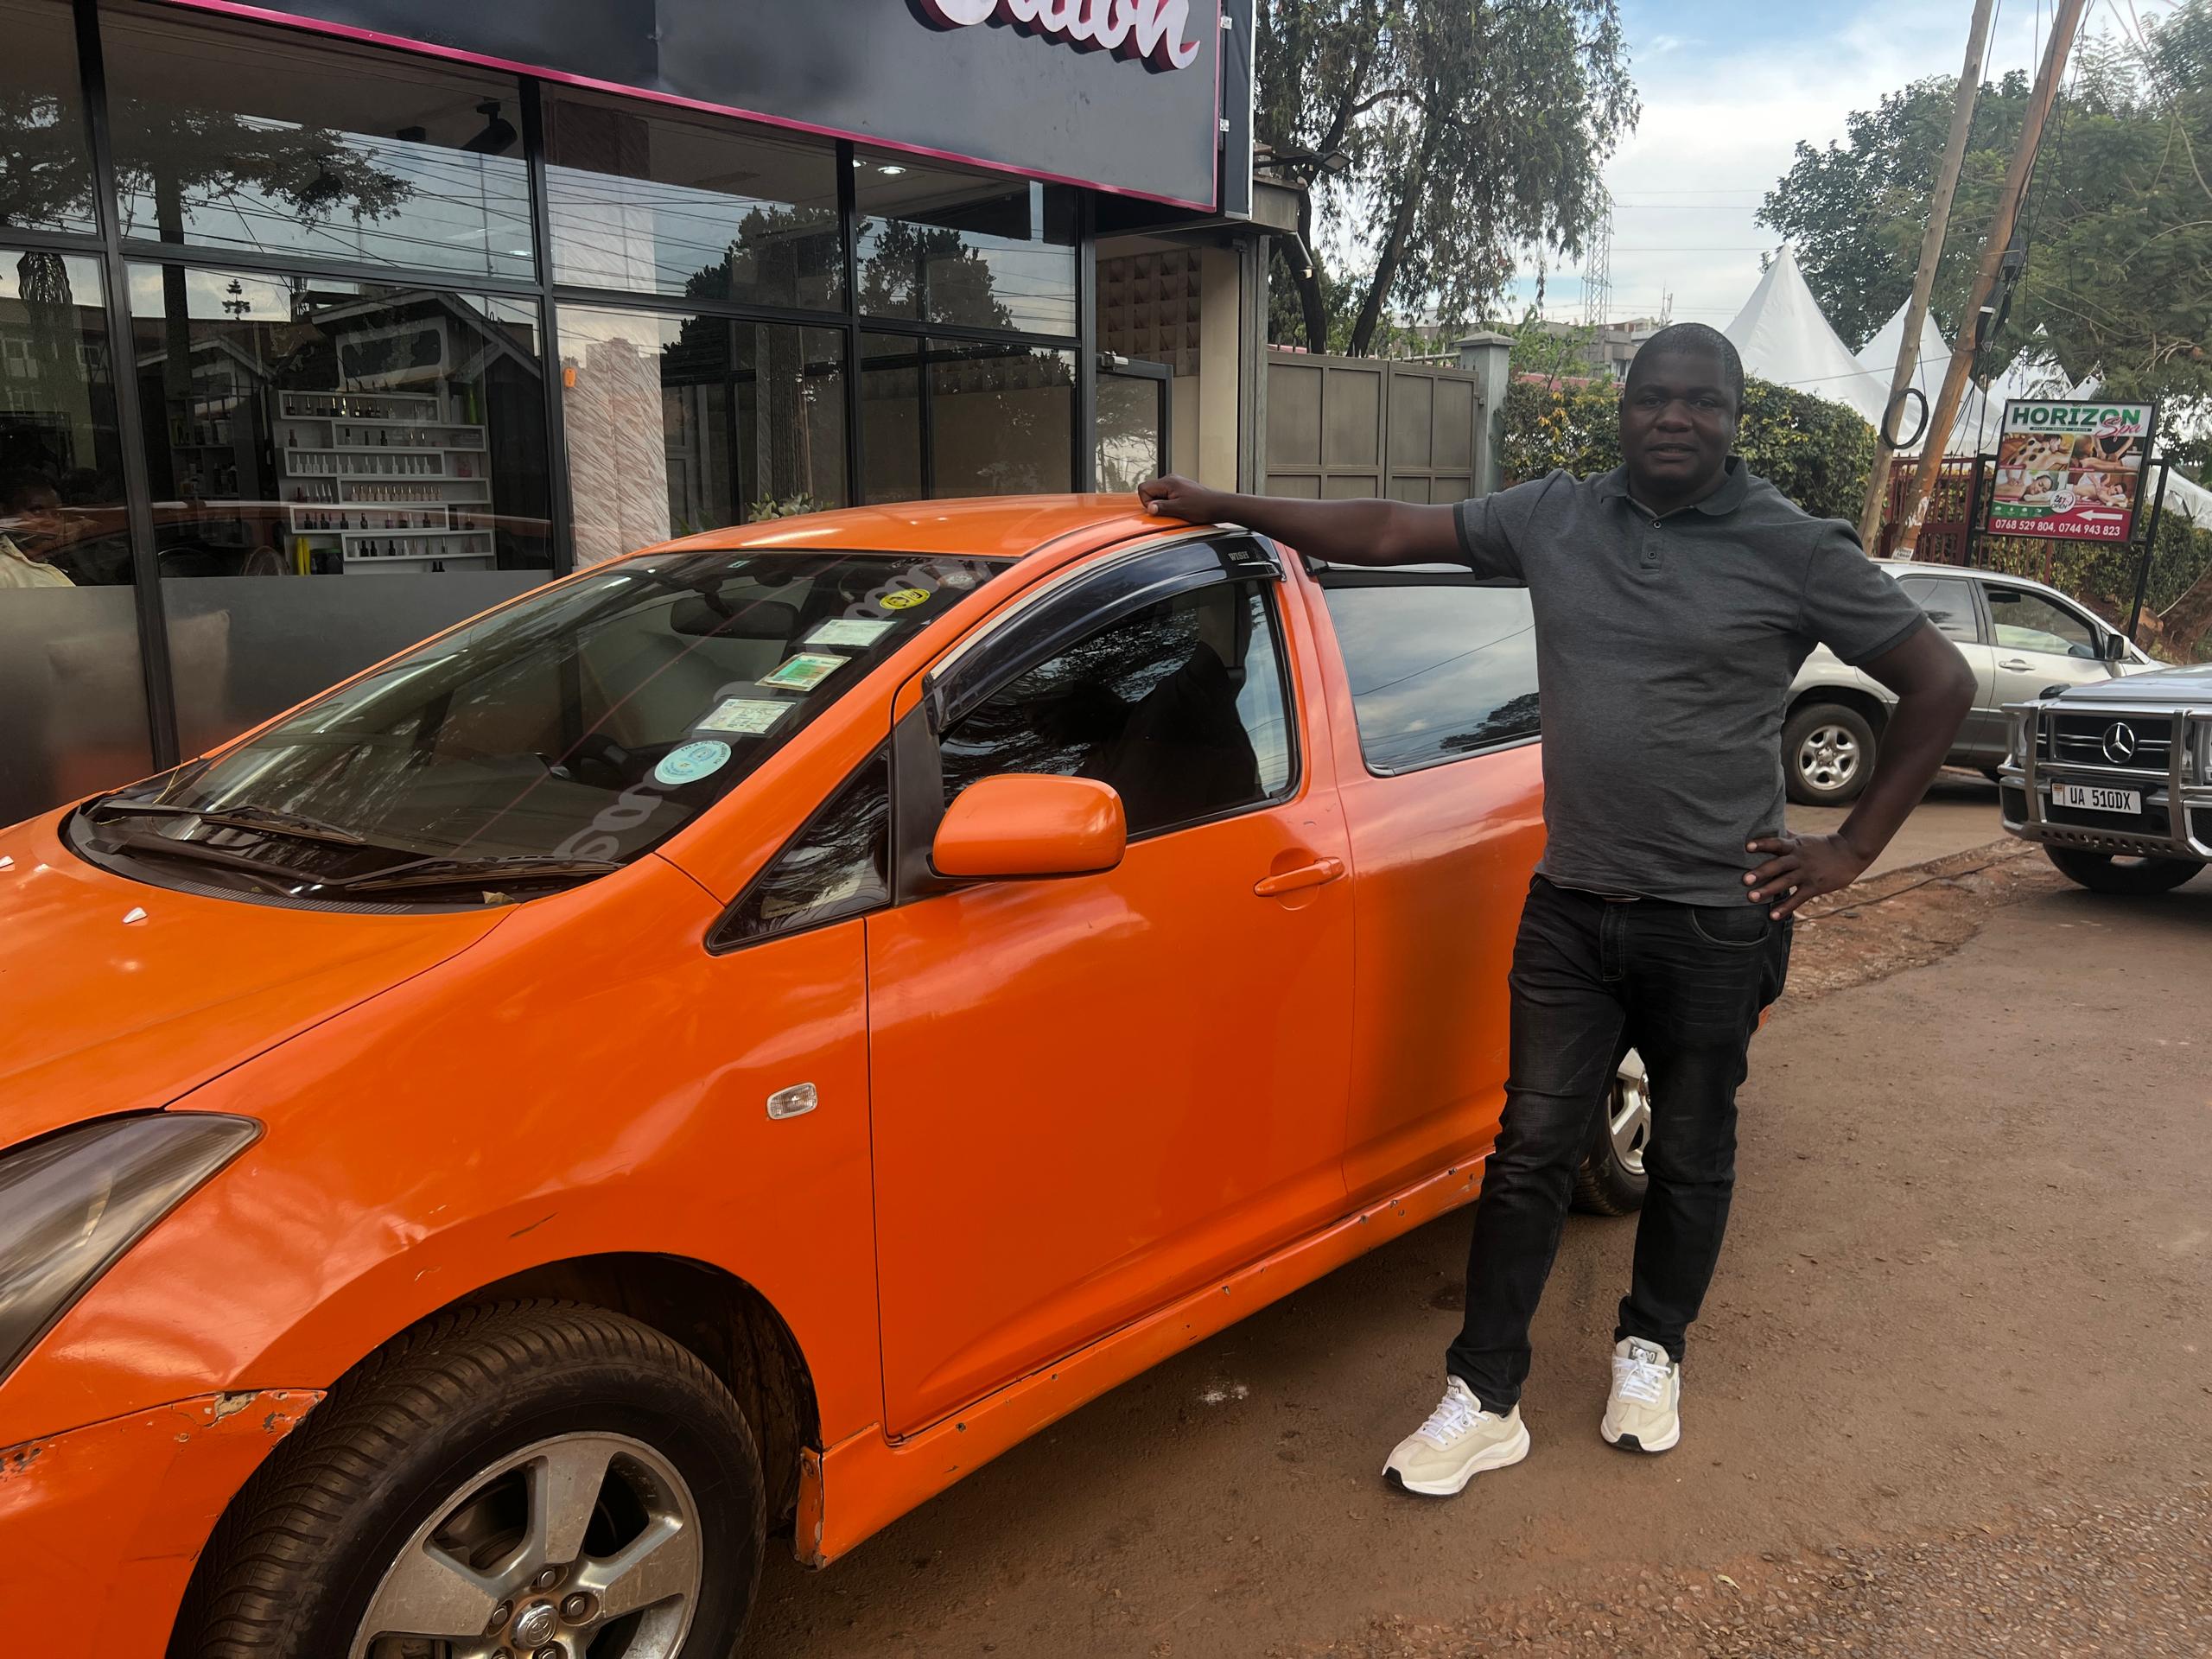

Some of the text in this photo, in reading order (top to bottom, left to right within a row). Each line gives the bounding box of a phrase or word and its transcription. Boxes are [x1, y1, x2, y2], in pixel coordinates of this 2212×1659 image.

[2012, 407, 2141, 426] HORIZON
[2095, 416, 2143, 442] Spa
[1995, 518, 2120, 536] 0768 529 804, 0744 943 823
[1228, 551, 1249, 561] WISH
[2070, 787, 2131, 810] UA 510DX
